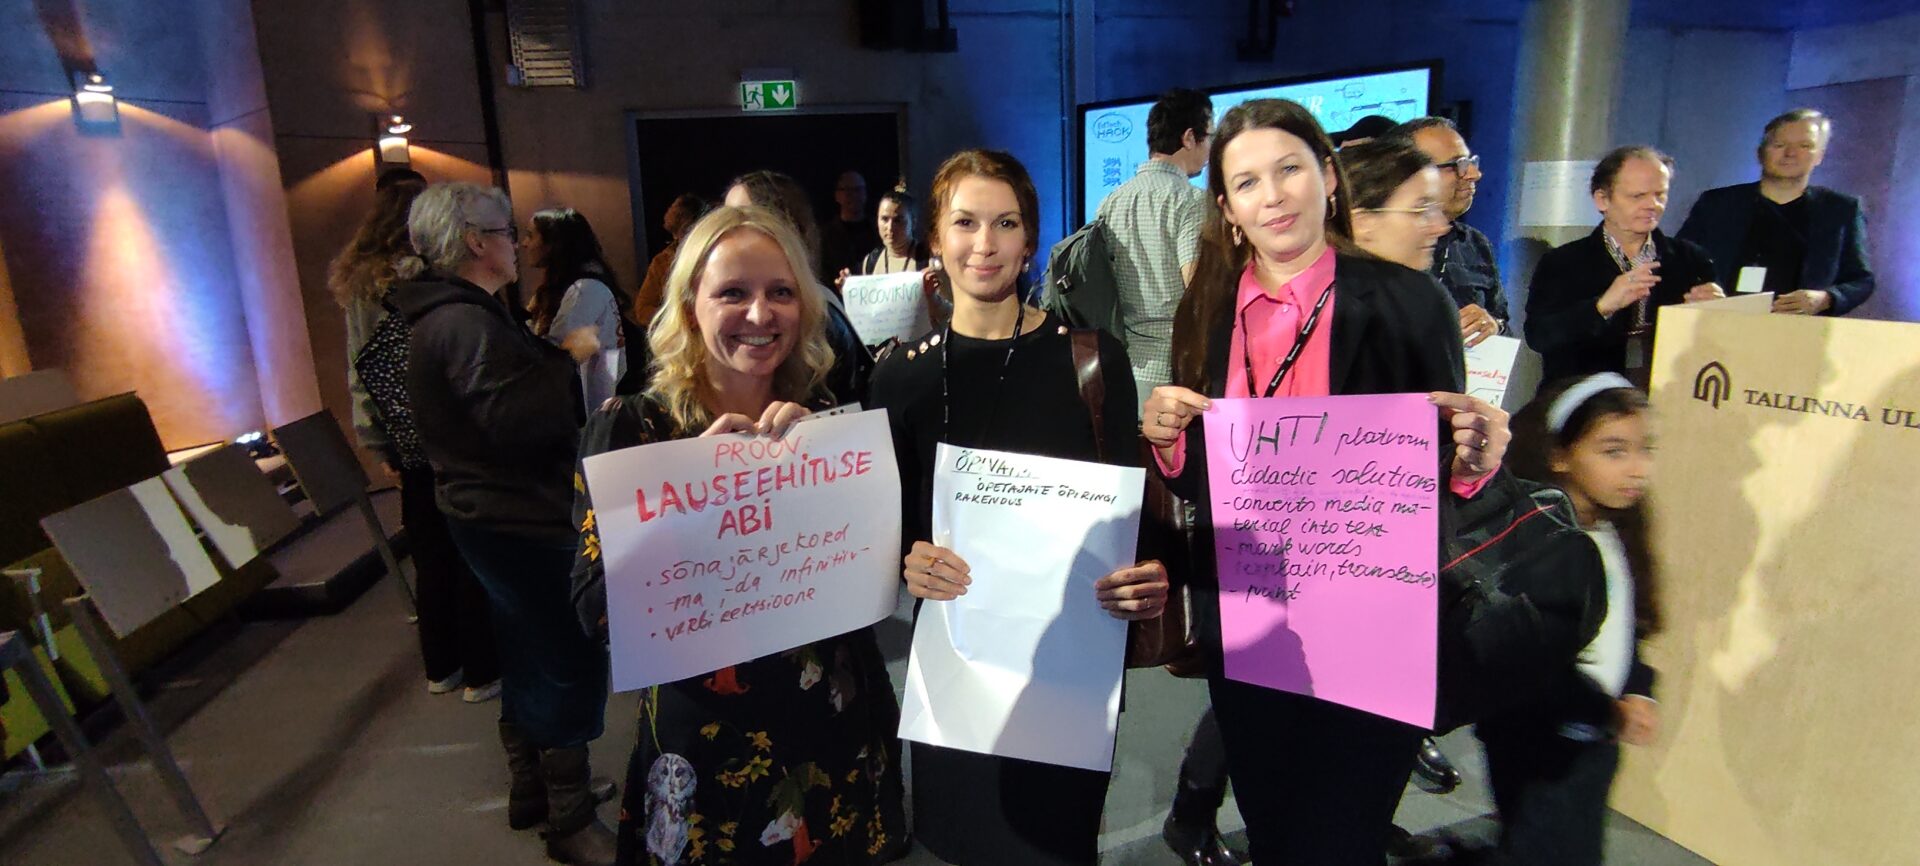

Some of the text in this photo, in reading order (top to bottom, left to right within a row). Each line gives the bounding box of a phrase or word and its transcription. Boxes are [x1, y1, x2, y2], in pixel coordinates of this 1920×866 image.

[1097, 127, 1130, 138] HACK
[1744, 390, 1871, 421] TALLINNA
[715, 436, 803, 467] PROOV
[636, 451, 873, 522] LAUSEEHITUSE
[1231, 460, 1437, 492] didactic solutions
[955, 492, 1023, 506] RAKENDUS
[1324, 495, 1386, 514] media
[717, 498, 772, 540] ABI
[1234, 517, 1389, 537] terial into text
[1299, 538, 1362, 556] words
